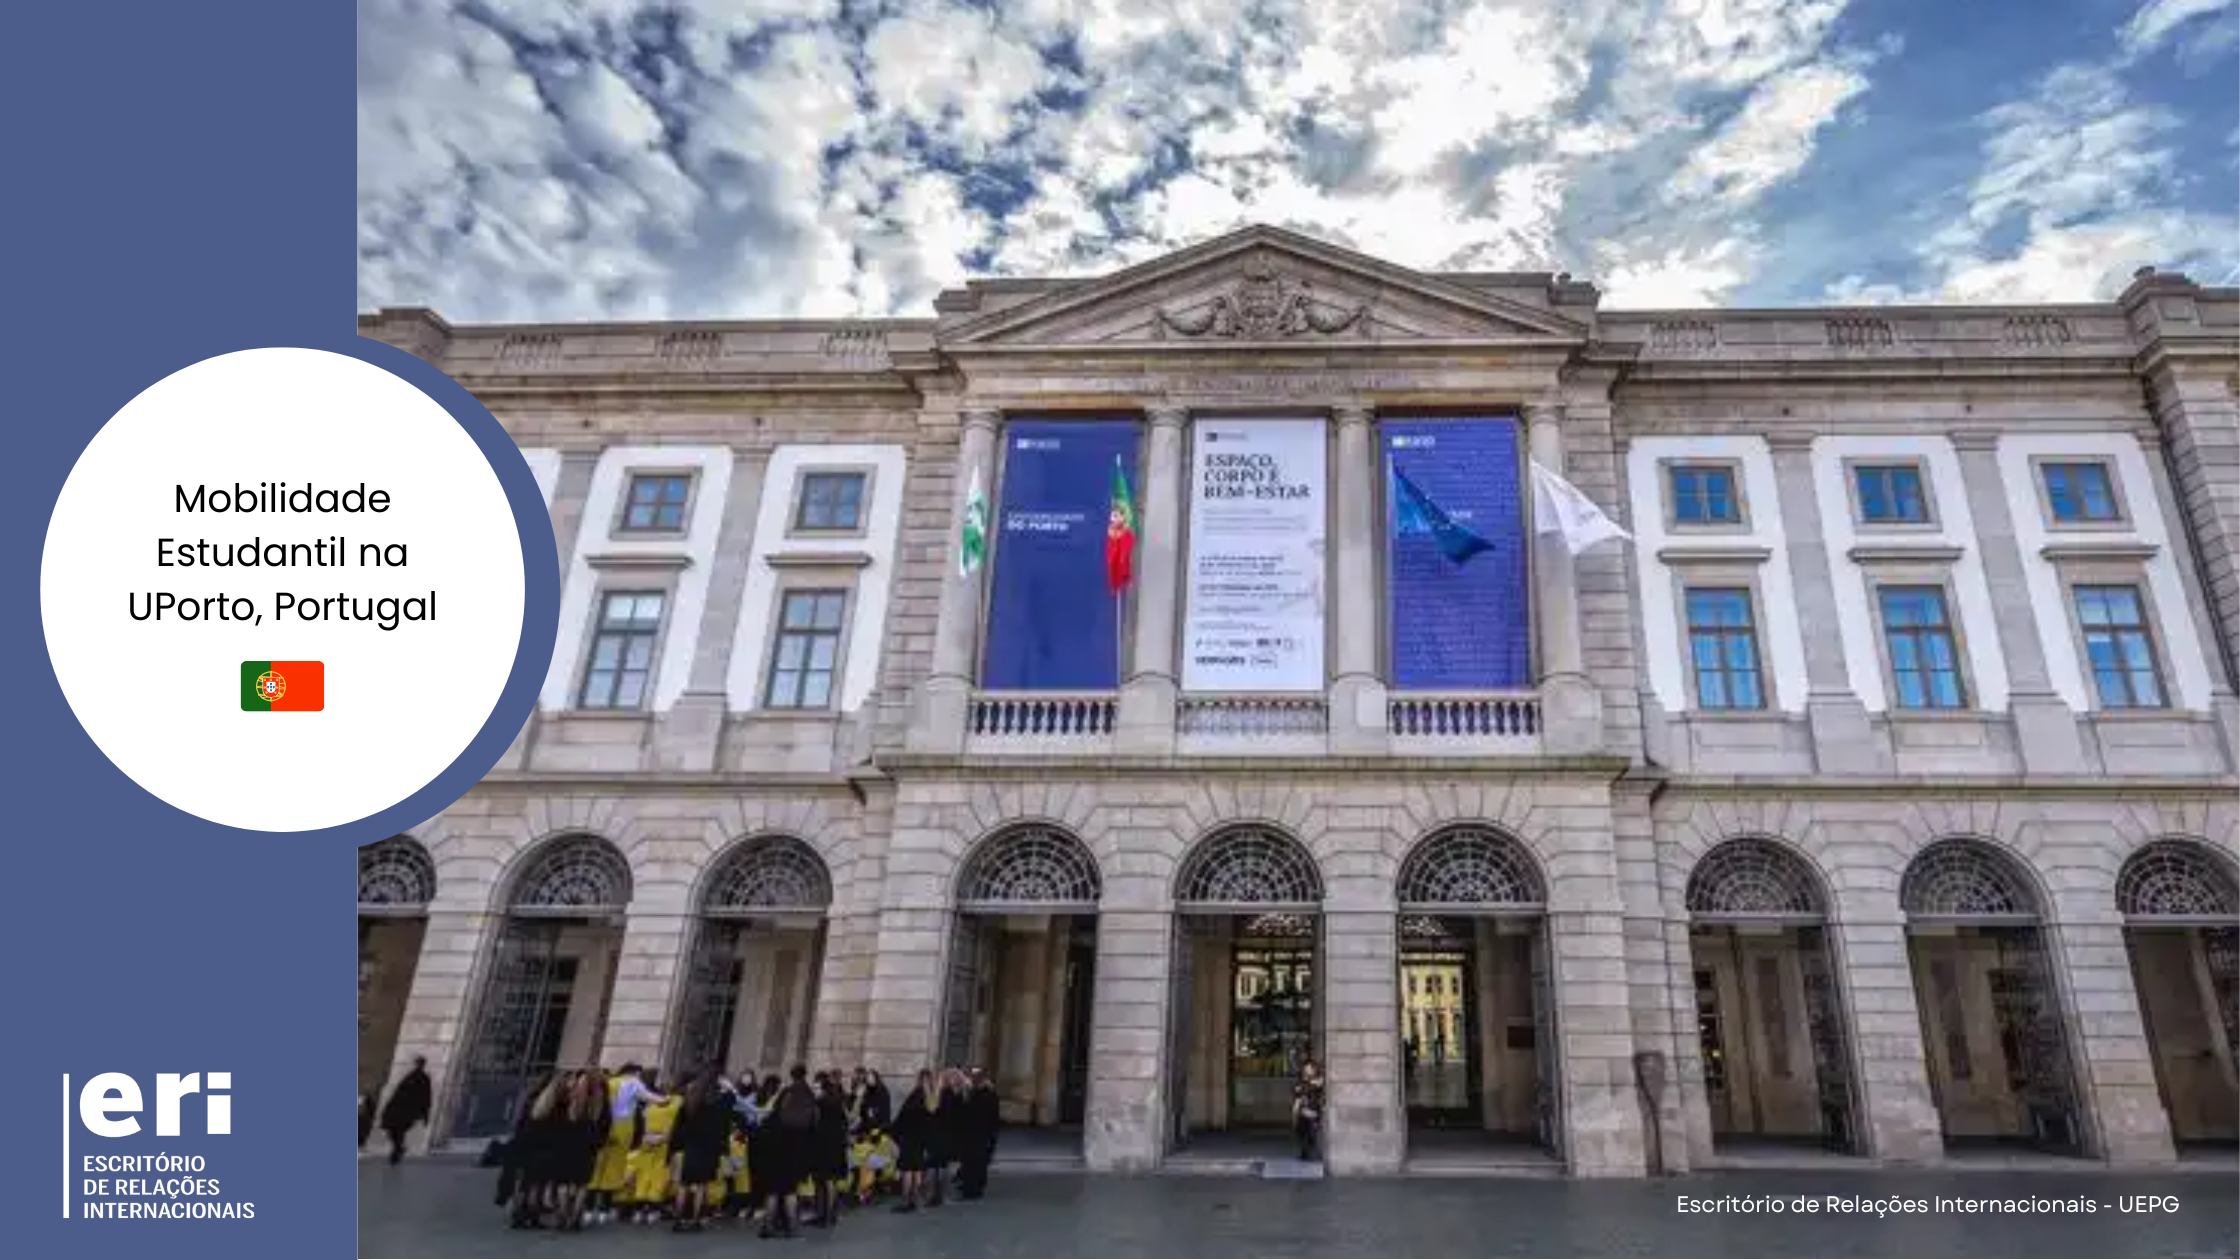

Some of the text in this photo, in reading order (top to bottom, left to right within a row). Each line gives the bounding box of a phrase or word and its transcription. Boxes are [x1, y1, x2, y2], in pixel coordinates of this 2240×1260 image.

[1204, 453, 1277, 471] ESPAÇO,
[1203, 468, 1264, 482] CORPO
[1203, 484, 1311, 499] BEM-ESTAR
